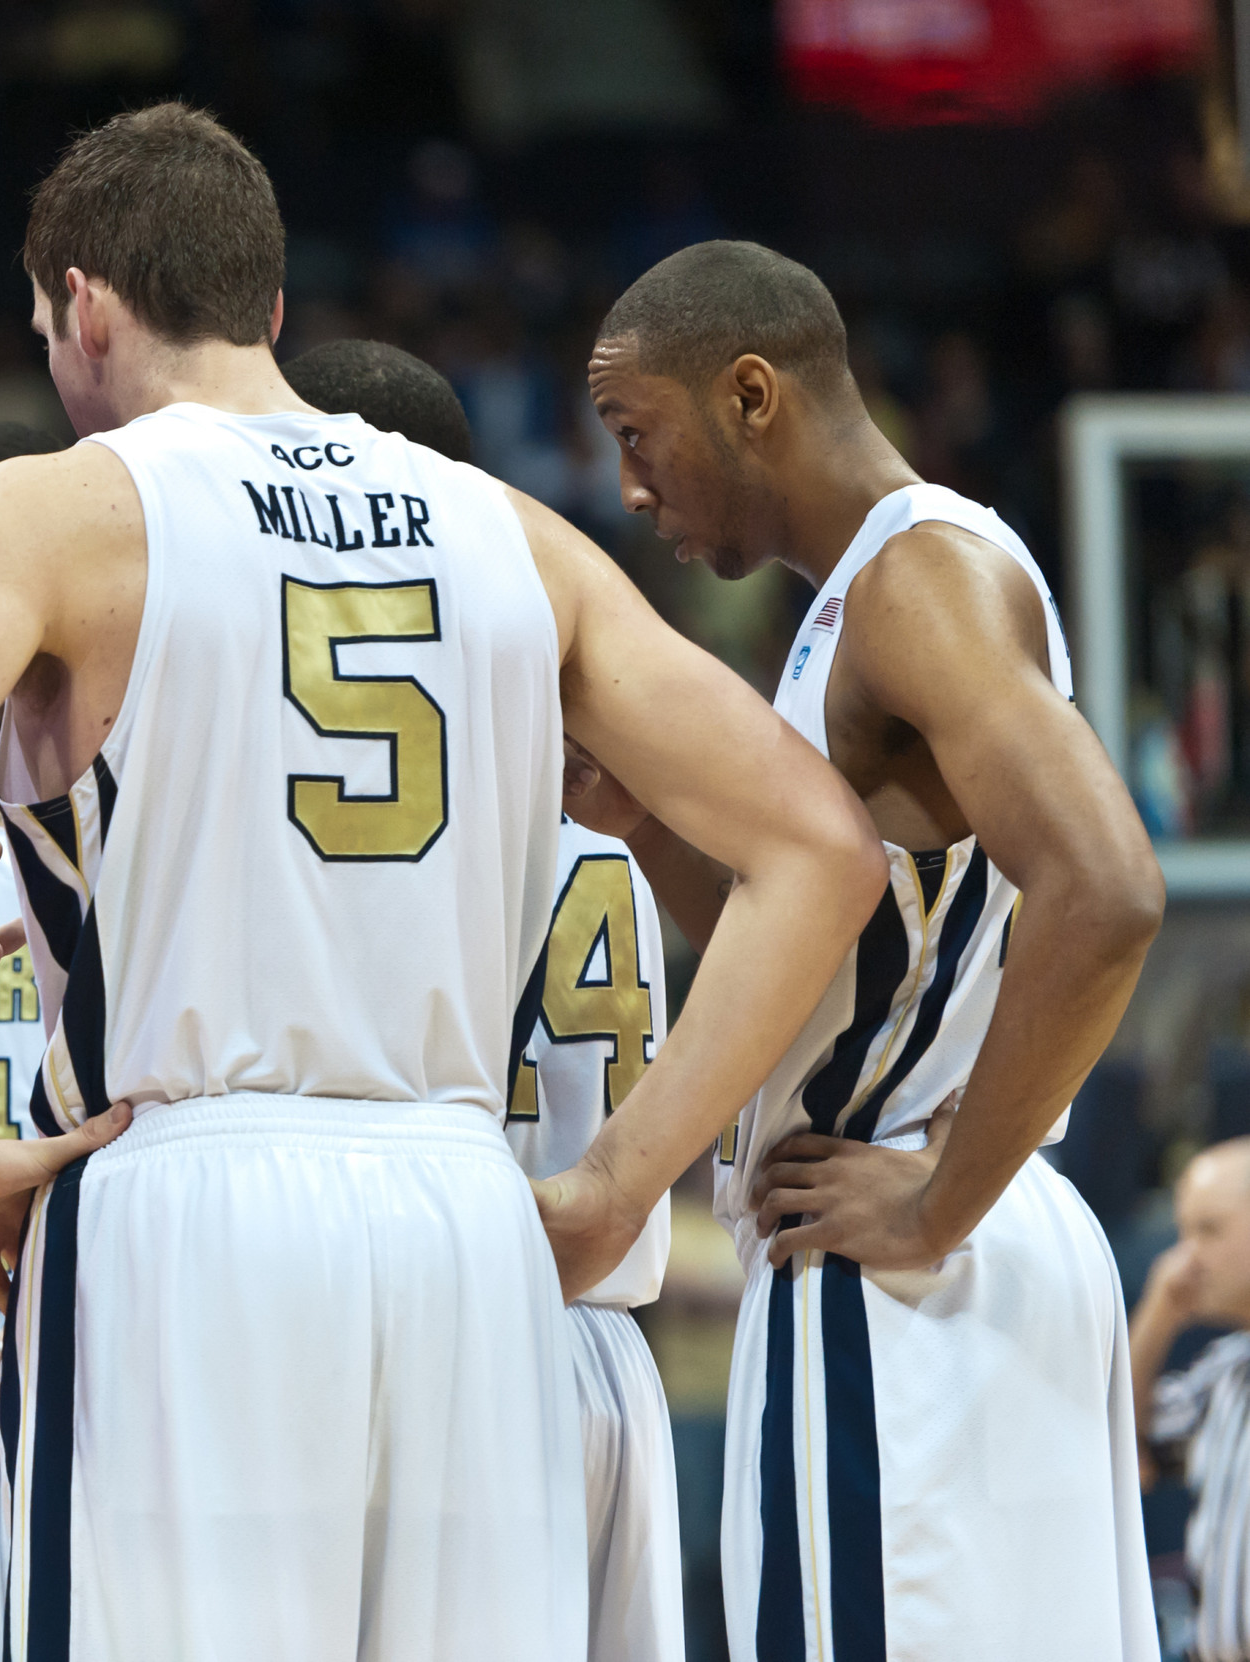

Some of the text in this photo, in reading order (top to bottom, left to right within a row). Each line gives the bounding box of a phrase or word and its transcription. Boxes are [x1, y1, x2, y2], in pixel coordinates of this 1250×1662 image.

[271, 442, 354, 470] ACC
[241, 480, 434, 552] MILLER
[281, 573, 448, 862] 5
